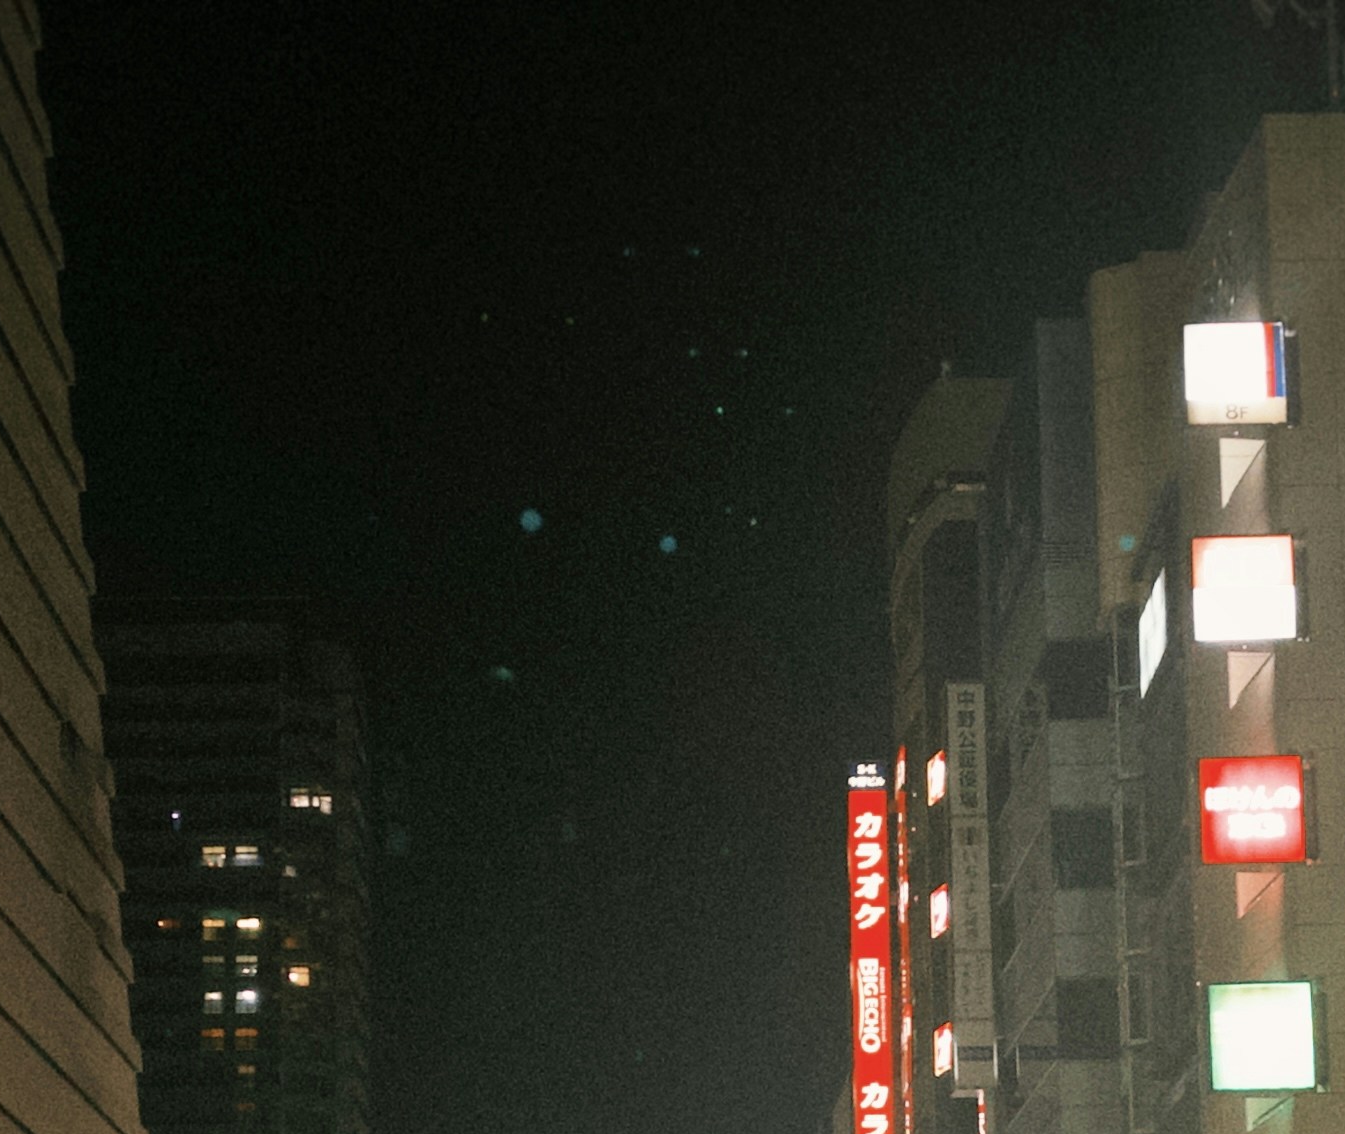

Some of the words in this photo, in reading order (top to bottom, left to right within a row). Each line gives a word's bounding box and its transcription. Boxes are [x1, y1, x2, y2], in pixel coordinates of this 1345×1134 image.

[1225, 403, 1248, 420] 8F
[853, 811, 886, 931] カラオケ
[858, 958, 880, 996] BIG
[861, 997, 882, 1054] ECHO
